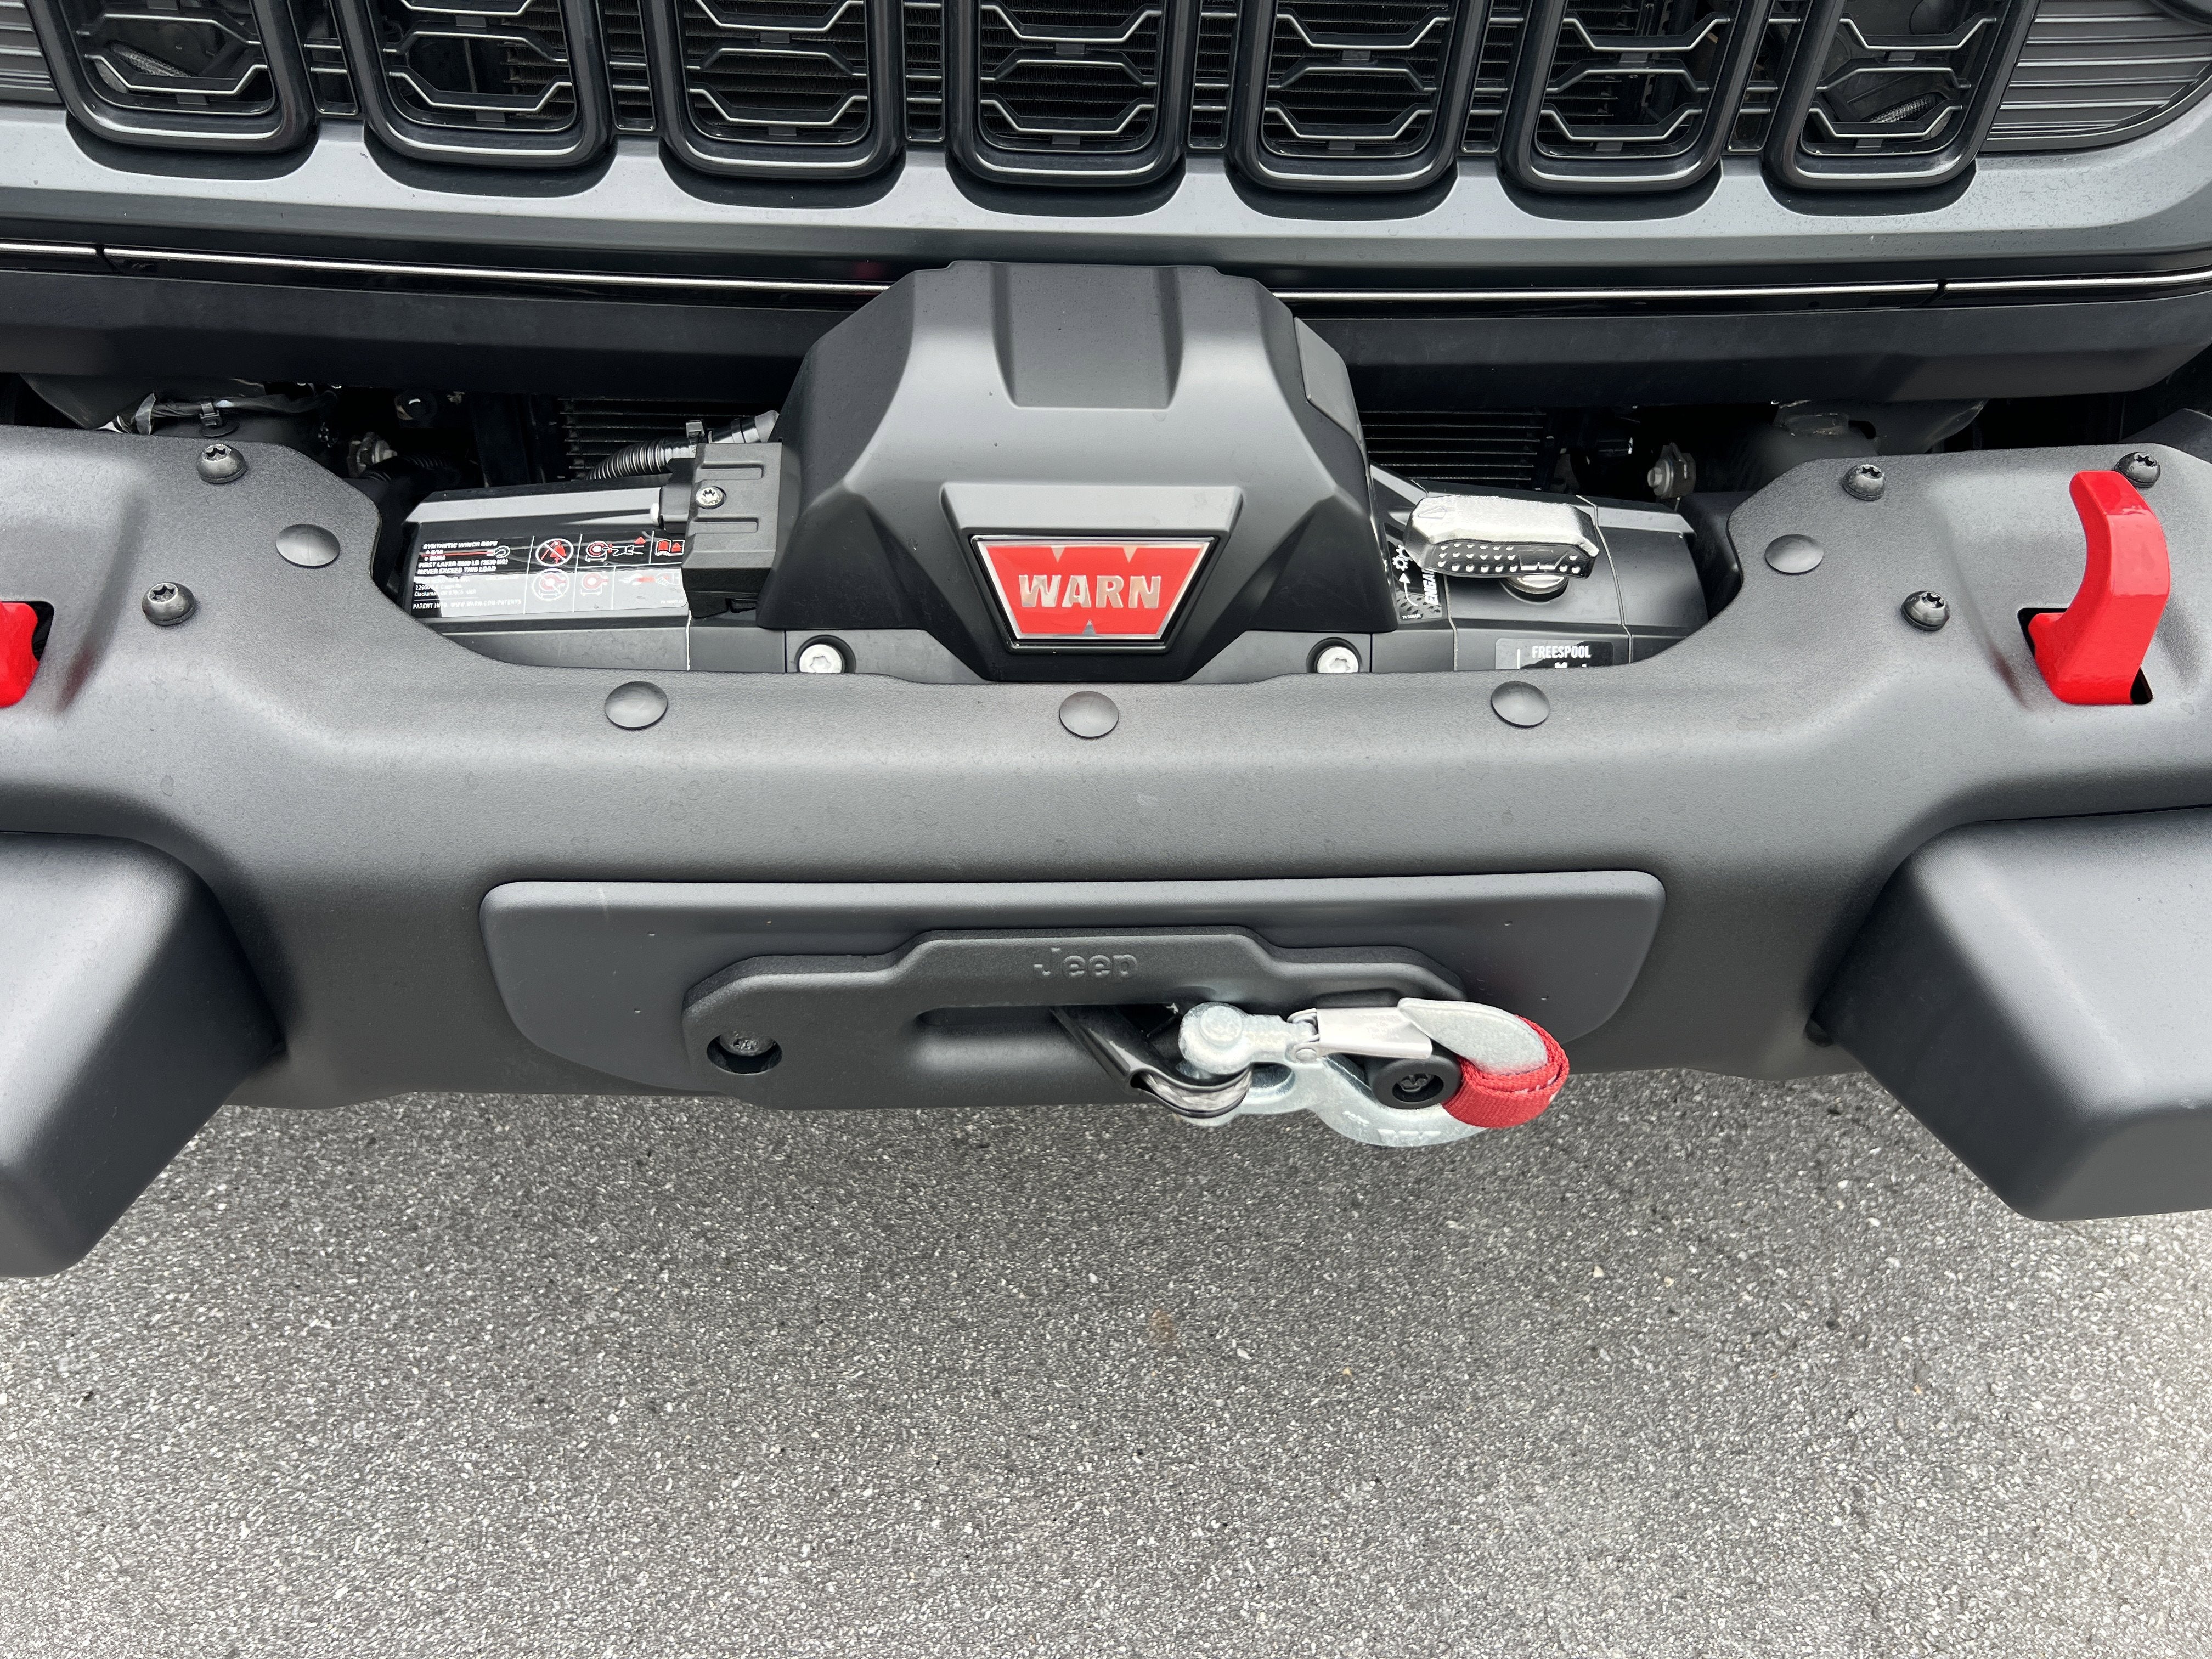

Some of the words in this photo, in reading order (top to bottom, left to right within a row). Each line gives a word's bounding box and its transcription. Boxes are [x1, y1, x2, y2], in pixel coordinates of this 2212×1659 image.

[1018, 574, 1161, 609] WARN
[1532, 645, 1592, 658] FREESPOOL
[1033, 947, 1138, 983] Jeep
